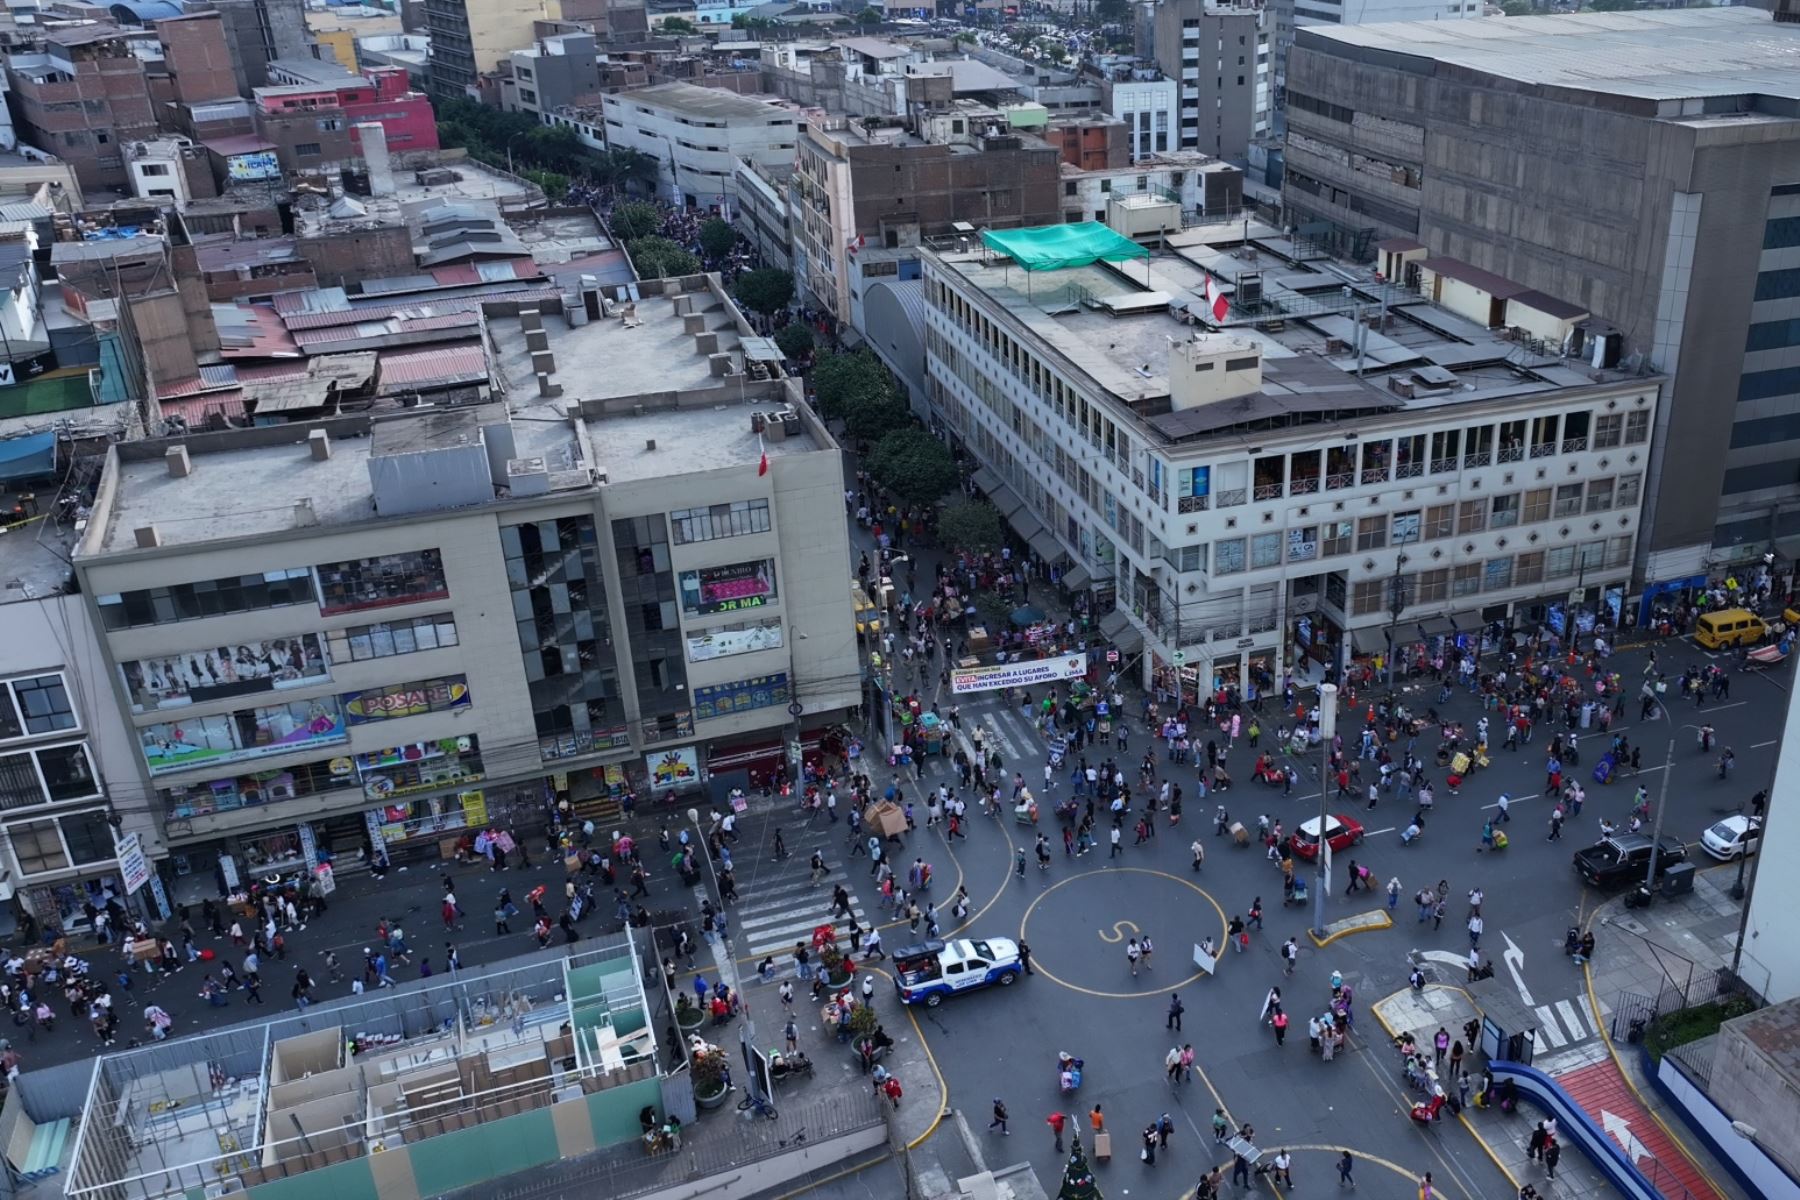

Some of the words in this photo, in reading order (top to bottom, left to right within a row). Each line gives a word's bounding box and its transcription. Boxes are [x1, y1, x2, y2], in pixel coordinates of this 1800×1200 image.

[956, 675, 976, 684] EVITA
[977, 672, 1011, 681] INGRESAR
[1018, 666, 1049, 676] LUGARES
[957, 683, 971, 691] QUE
[989, 677, 1022, 688] EXCEDIDO
[1034, 672, 1058, 682] AFORO
[1064, 669, 1084, 677] LIMA
